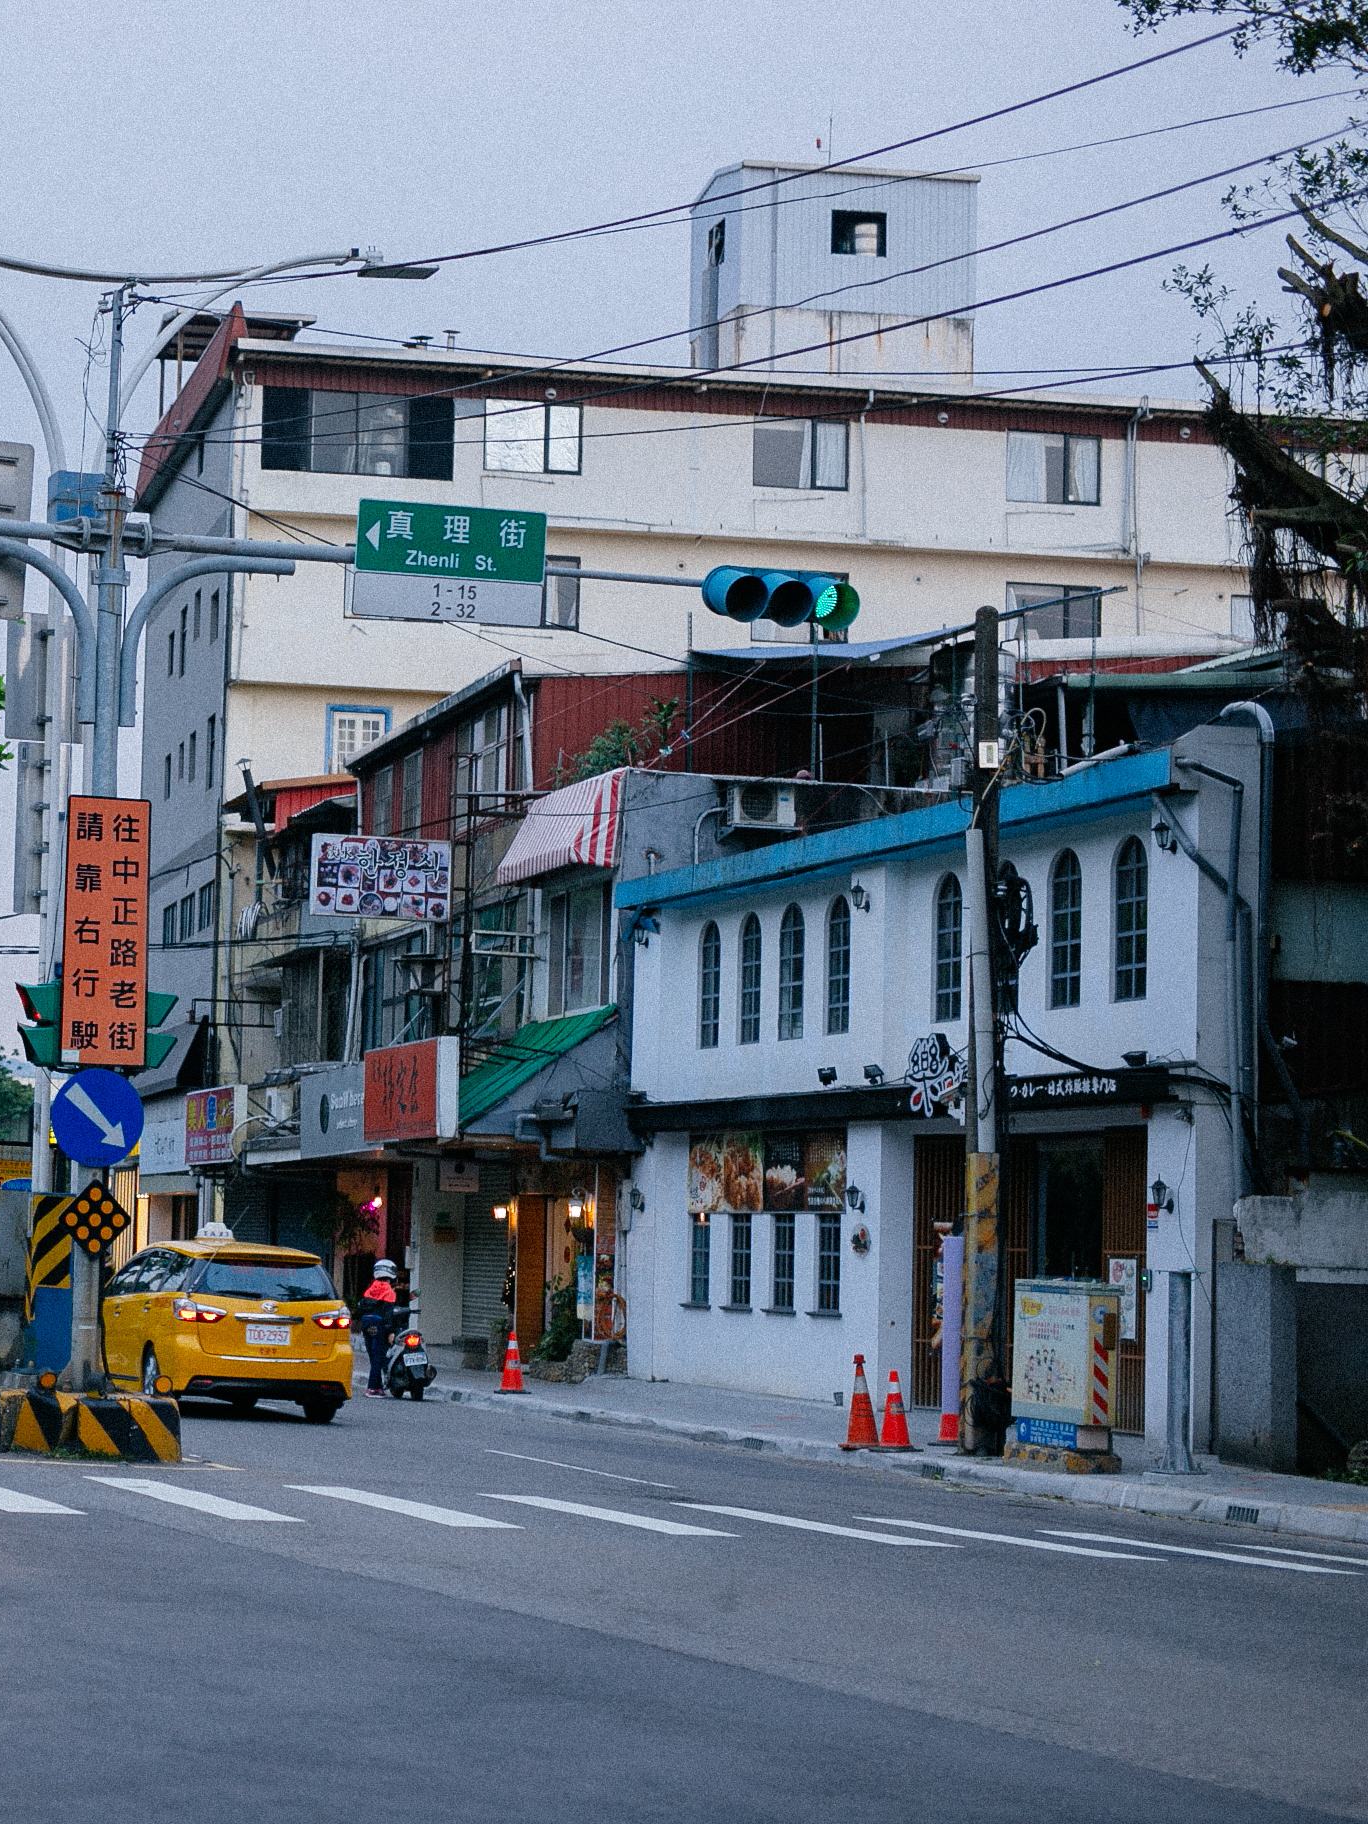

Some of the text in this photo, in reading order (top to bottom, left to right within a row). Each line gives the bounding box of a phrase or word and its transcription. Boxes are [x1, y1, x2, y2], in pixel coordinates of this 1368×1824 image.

[386, 510, 527, 549] 真理街
[405, 550, 497, 572] Zhenli St.
[356, 847, 441, 884] 한정식
[70, 812, 104, 1050] 請靠右行駛
[108, 813, 141, 1051] 往中正路老街
